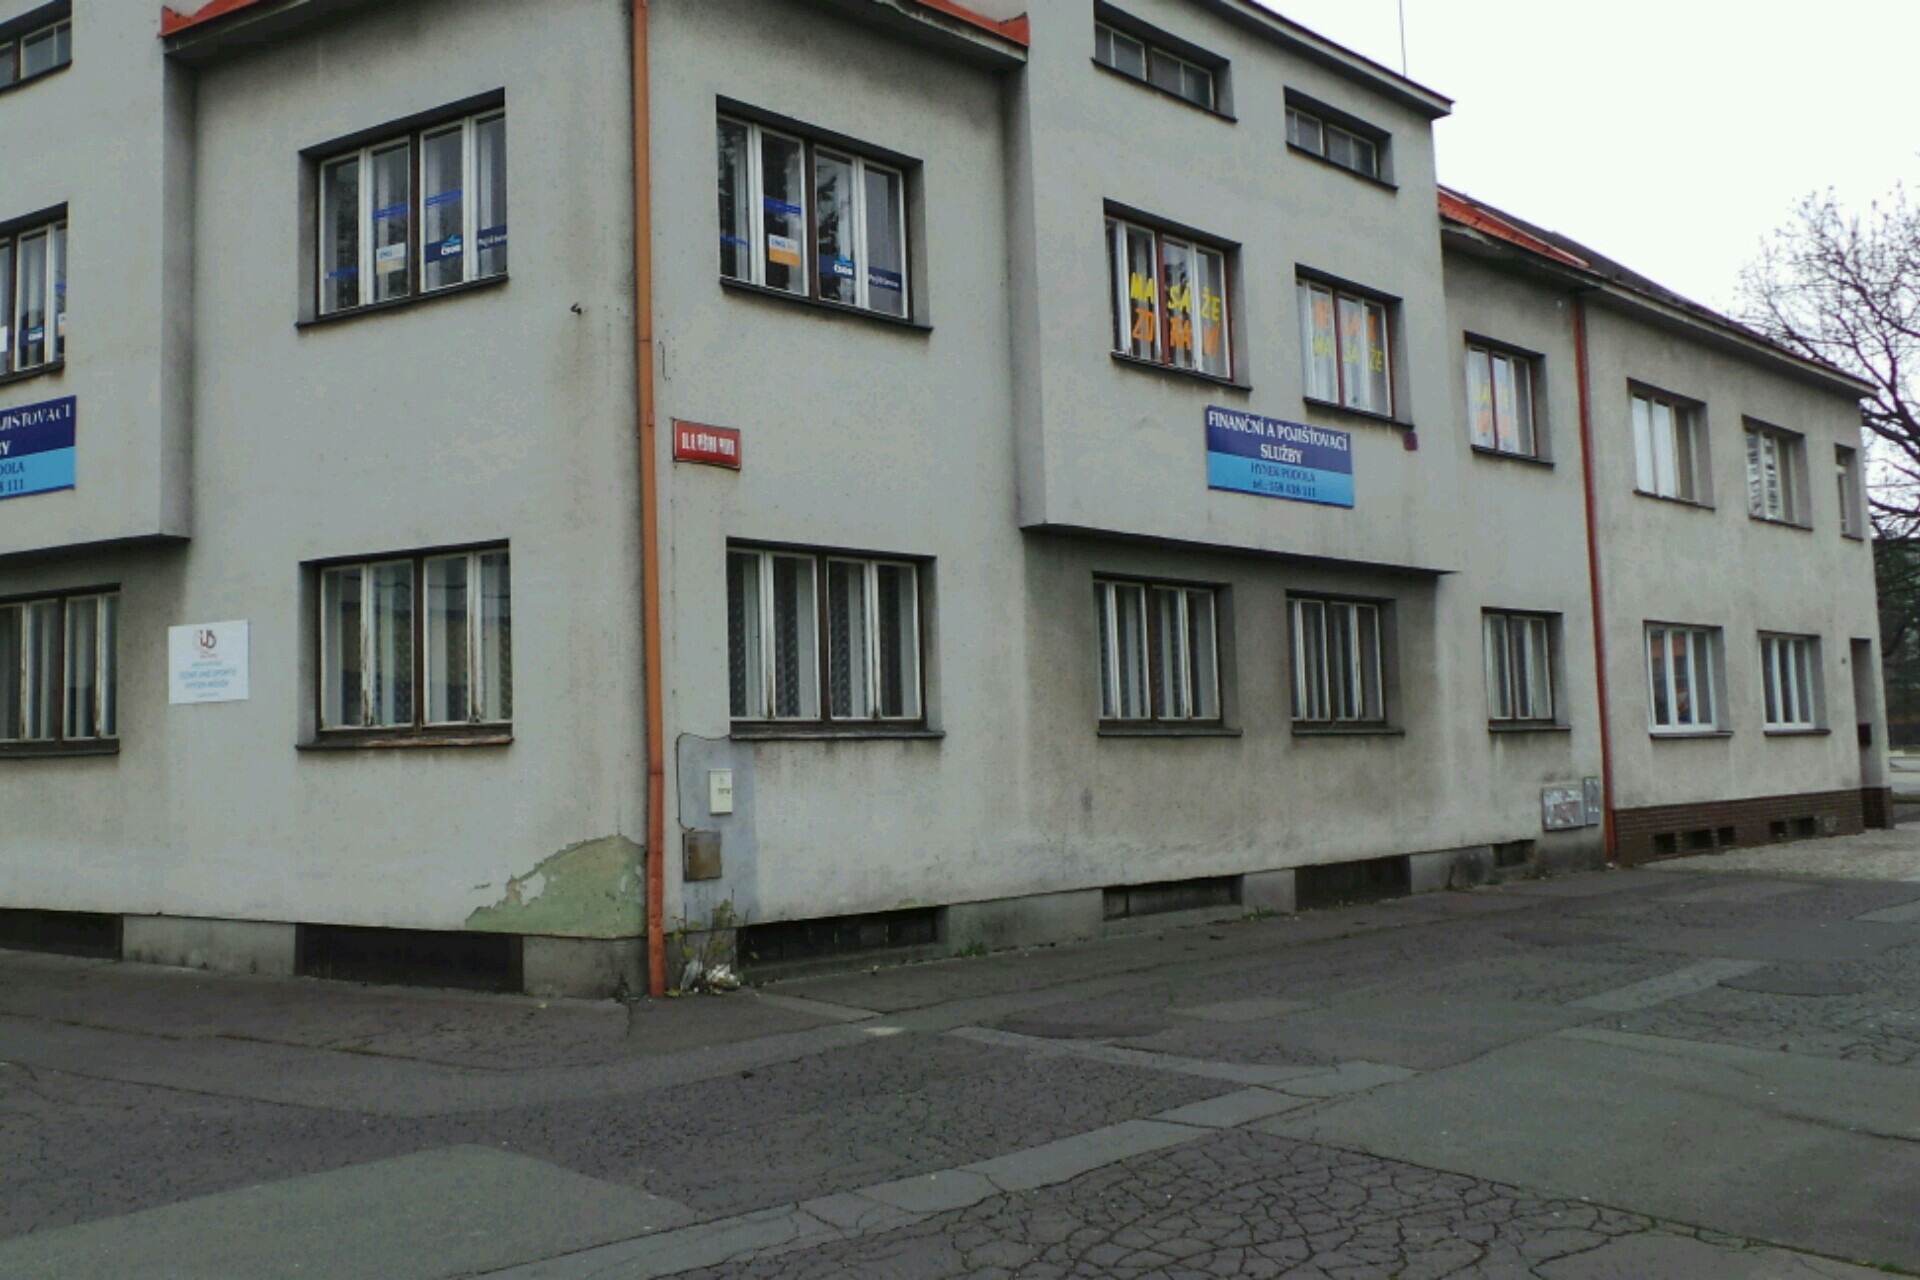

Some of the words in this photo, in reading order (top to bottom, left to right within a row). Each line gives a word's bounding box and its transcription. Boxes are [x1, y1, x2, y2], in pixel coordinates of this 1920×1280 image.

[1208, 410, 1265, 436] FINANČNÍ
[1266, 425, 1276, 438] A
[1260, 443, 1303, 464] SLUŽBY
